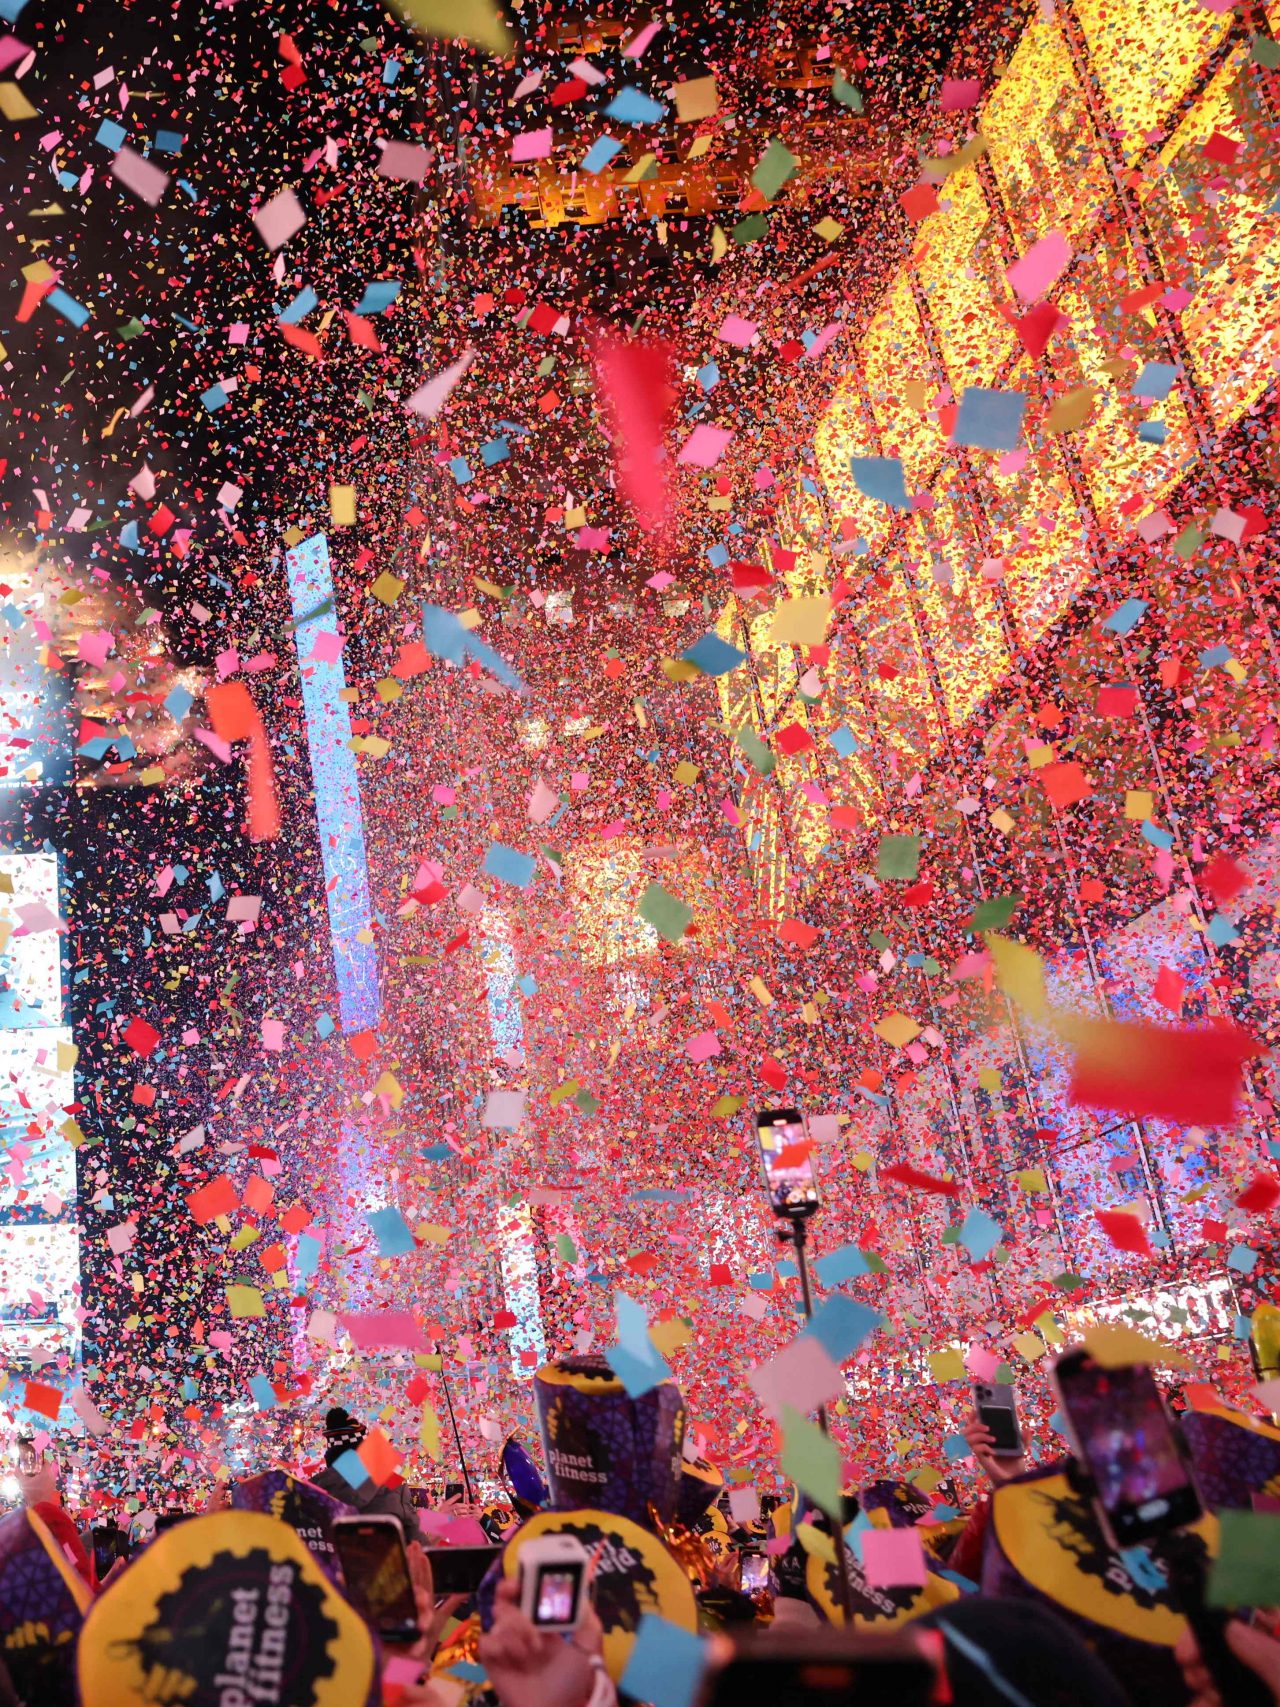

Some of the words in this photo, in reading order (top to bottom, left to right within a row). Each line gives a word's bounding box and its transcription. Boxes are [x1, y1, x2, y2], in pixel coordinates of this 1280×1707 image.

[548, 1449, 593, 1469] planet
[554, 1461, 608, 1484] fitness
[296, 1527, 323, 1539] net
[245, 1564, 304, 1704] fitness
